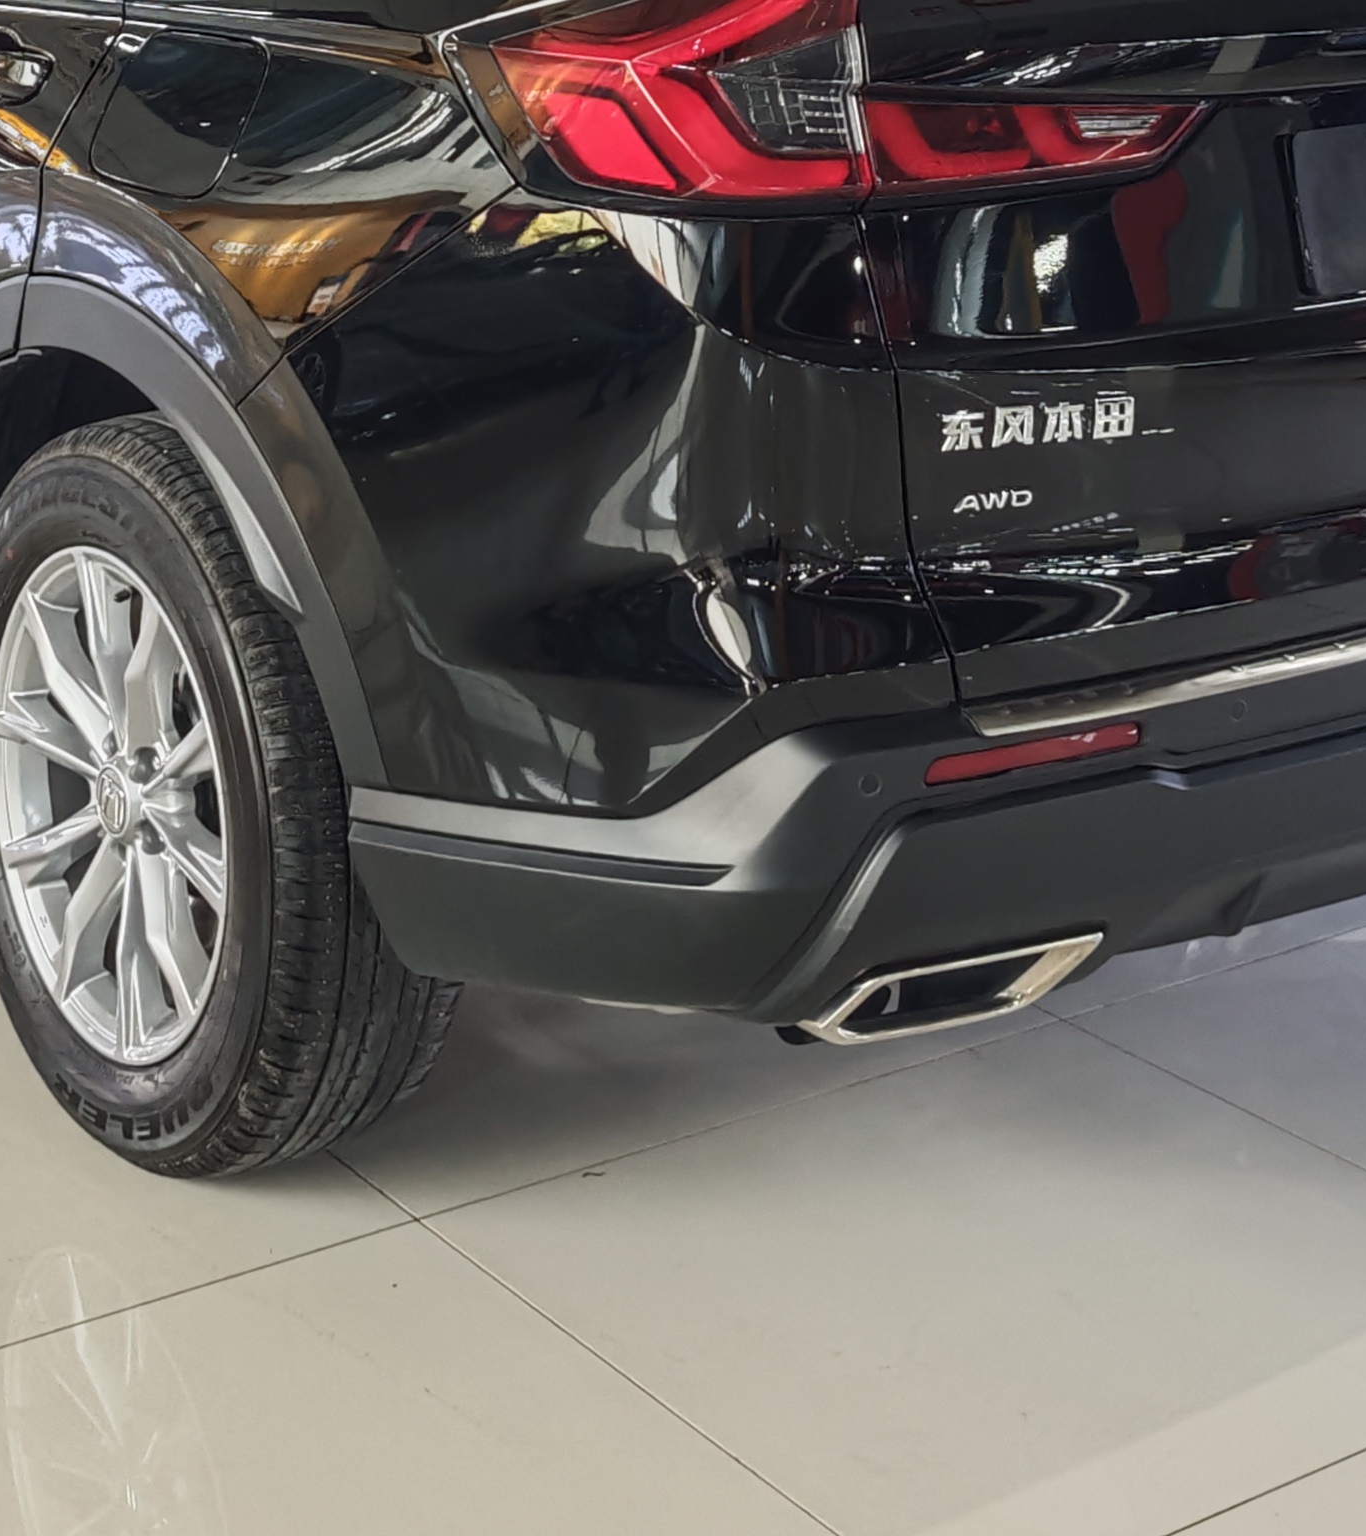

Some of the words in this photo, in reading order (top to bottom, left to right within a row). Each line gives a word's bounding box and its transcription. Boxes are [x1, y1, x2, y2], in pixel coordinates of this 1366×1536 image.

[941, 396, 1135, 452] 东风本田
[953, 488, 1033, 514] AWD
